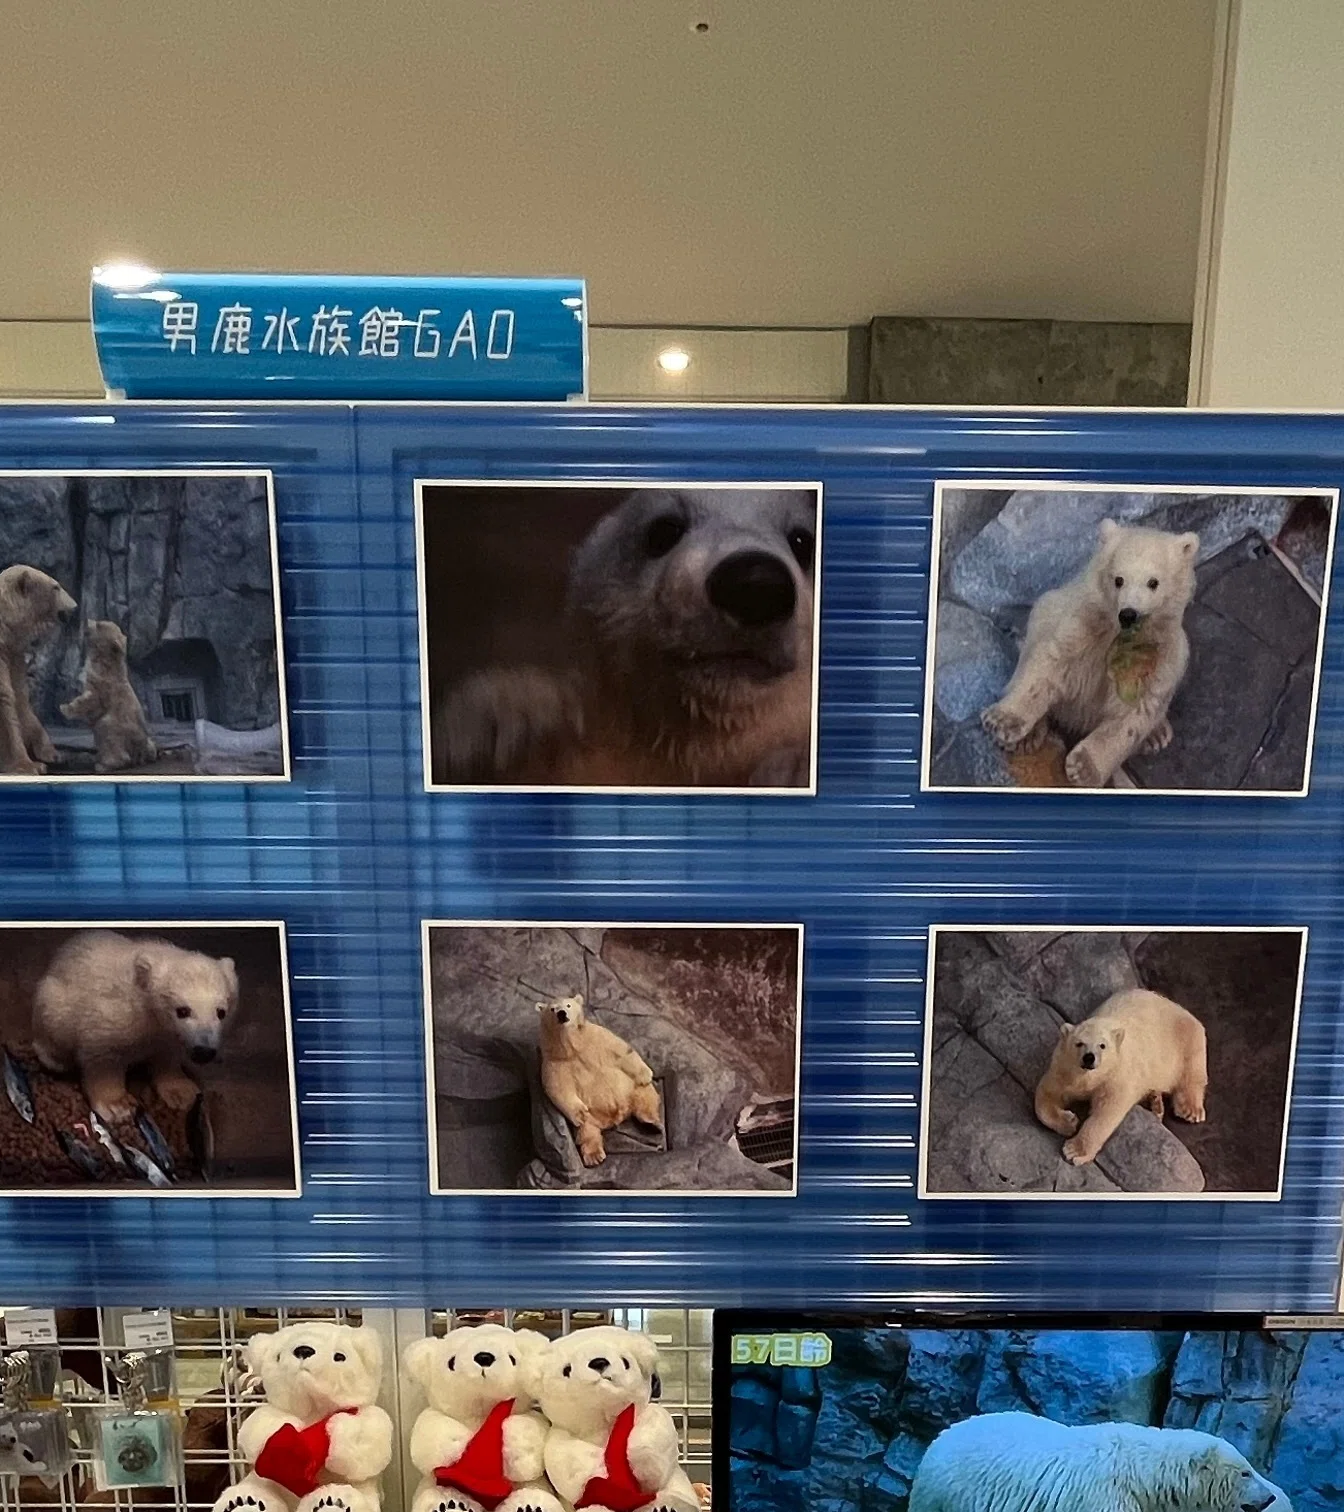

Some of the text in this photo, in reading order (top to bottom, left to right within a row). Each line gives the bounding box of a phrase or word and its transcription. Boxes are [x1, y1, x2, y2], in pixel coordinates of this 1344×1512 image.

[162, 300, 515, 360] 男鹿水族館GAO
